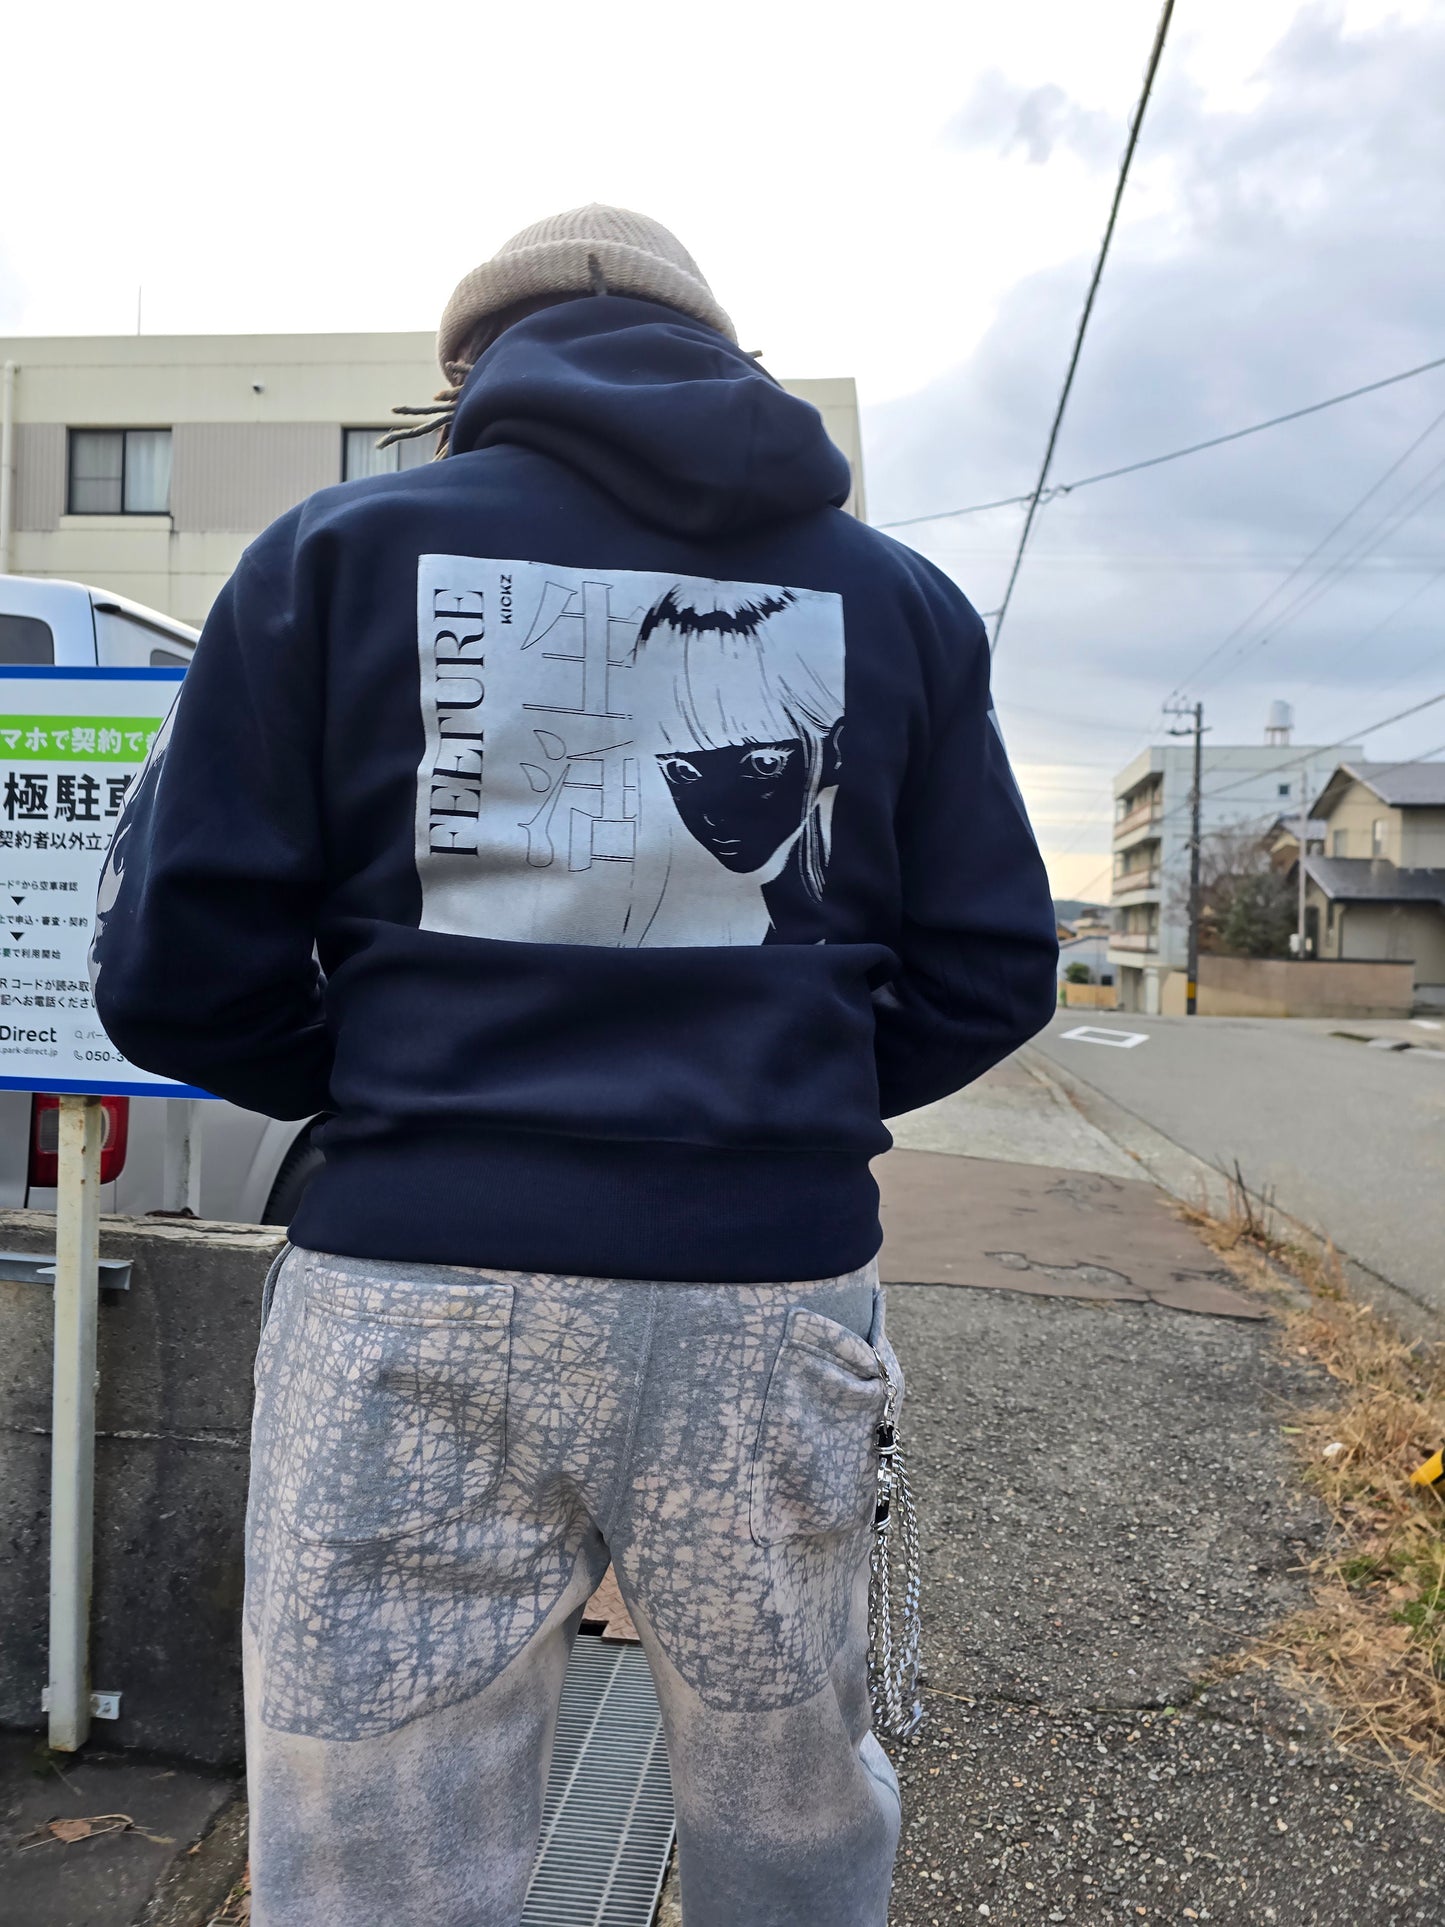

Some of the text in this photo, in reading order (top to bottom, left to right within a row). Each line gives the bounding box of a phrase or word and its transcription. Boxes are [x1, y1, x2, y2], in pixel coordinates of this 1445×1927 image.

[500, 574, 513, 625] KICKZ
[429, 588, 486, 857] FEETURE
[0, 947, 61, 960] 要で利用開始
[0, 1025, 57, 1043] Direct
